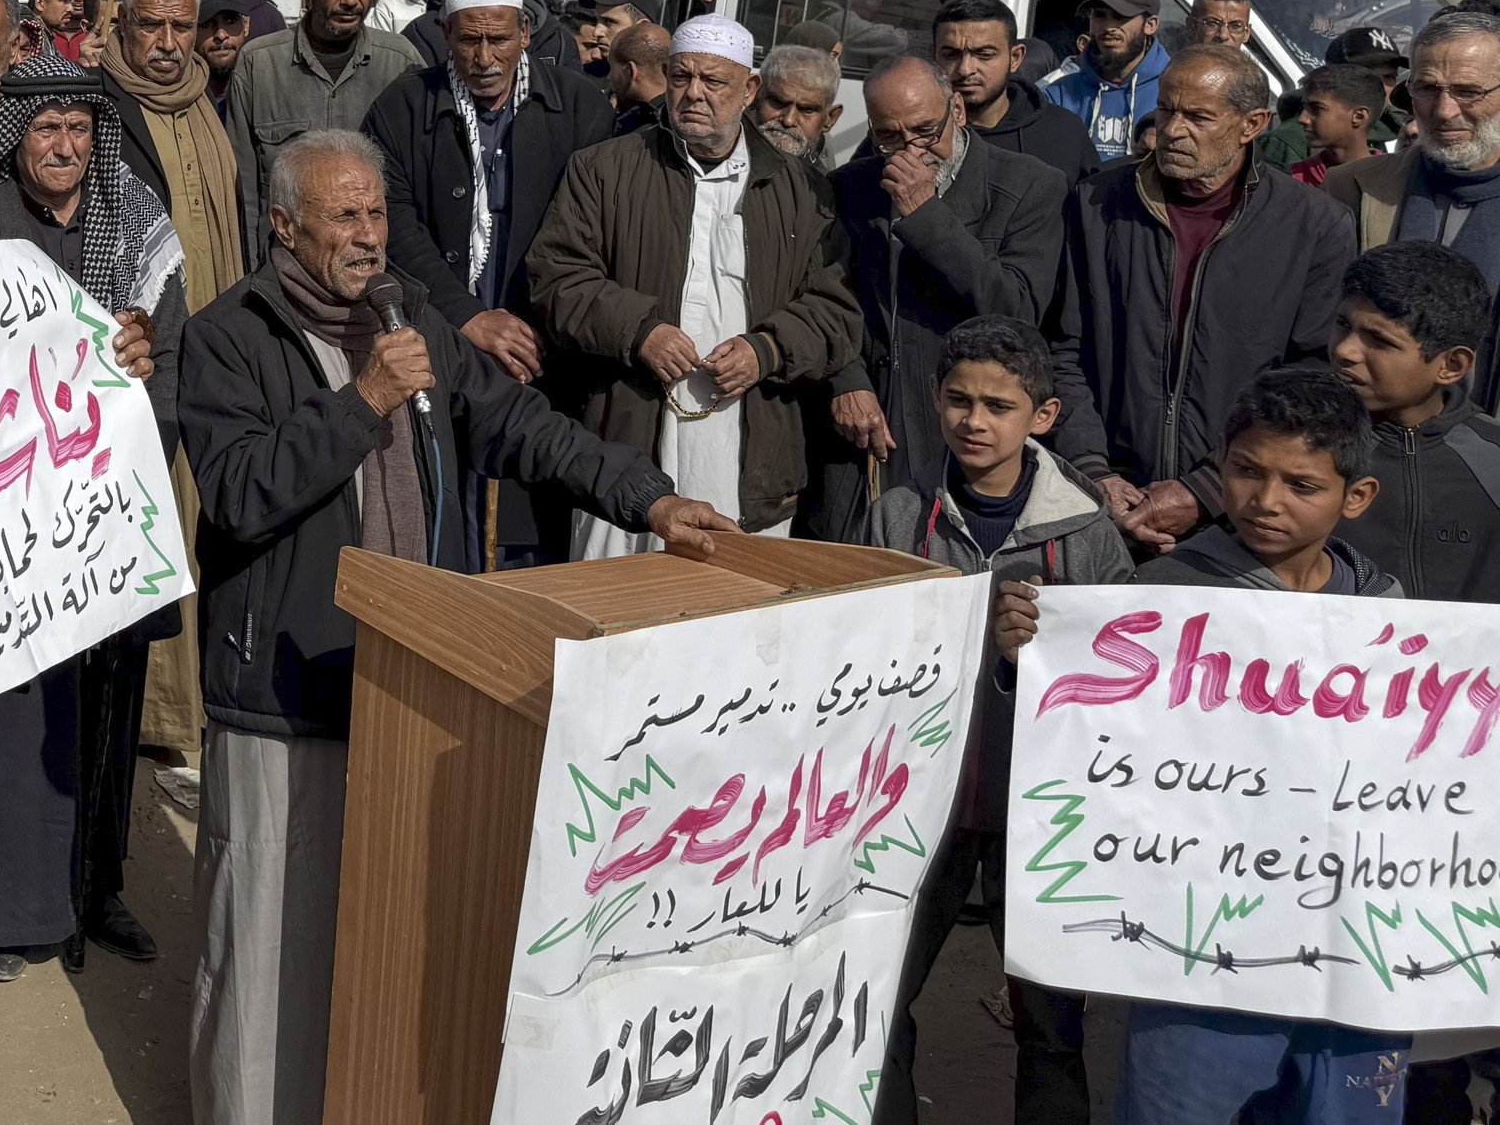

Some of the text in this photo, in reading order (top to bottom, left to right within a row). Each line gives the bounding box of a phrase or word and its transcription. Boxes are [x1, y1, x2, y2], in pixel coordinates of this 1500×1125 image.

[1369, 29, 1394, 51] NY
[109, 557, 137, 595] من
[815, 662, 872, 728] يومي
[878, 643, 942, 699] قصف
[604, 693, 705, 762] مستمر
[700, 678, 780, 736] تدمير
[1087, 734, 1134, 788] is
[1154, 758, 1268, 797] ours
[752, 723, 910, 889] والعالم
[795, 865, 811, 915] يا
[1092, 830, 1500, 910] our neighborho
[686, 878, 782, 933] للعار
[730, 950, 869, 1106] المرحلة
